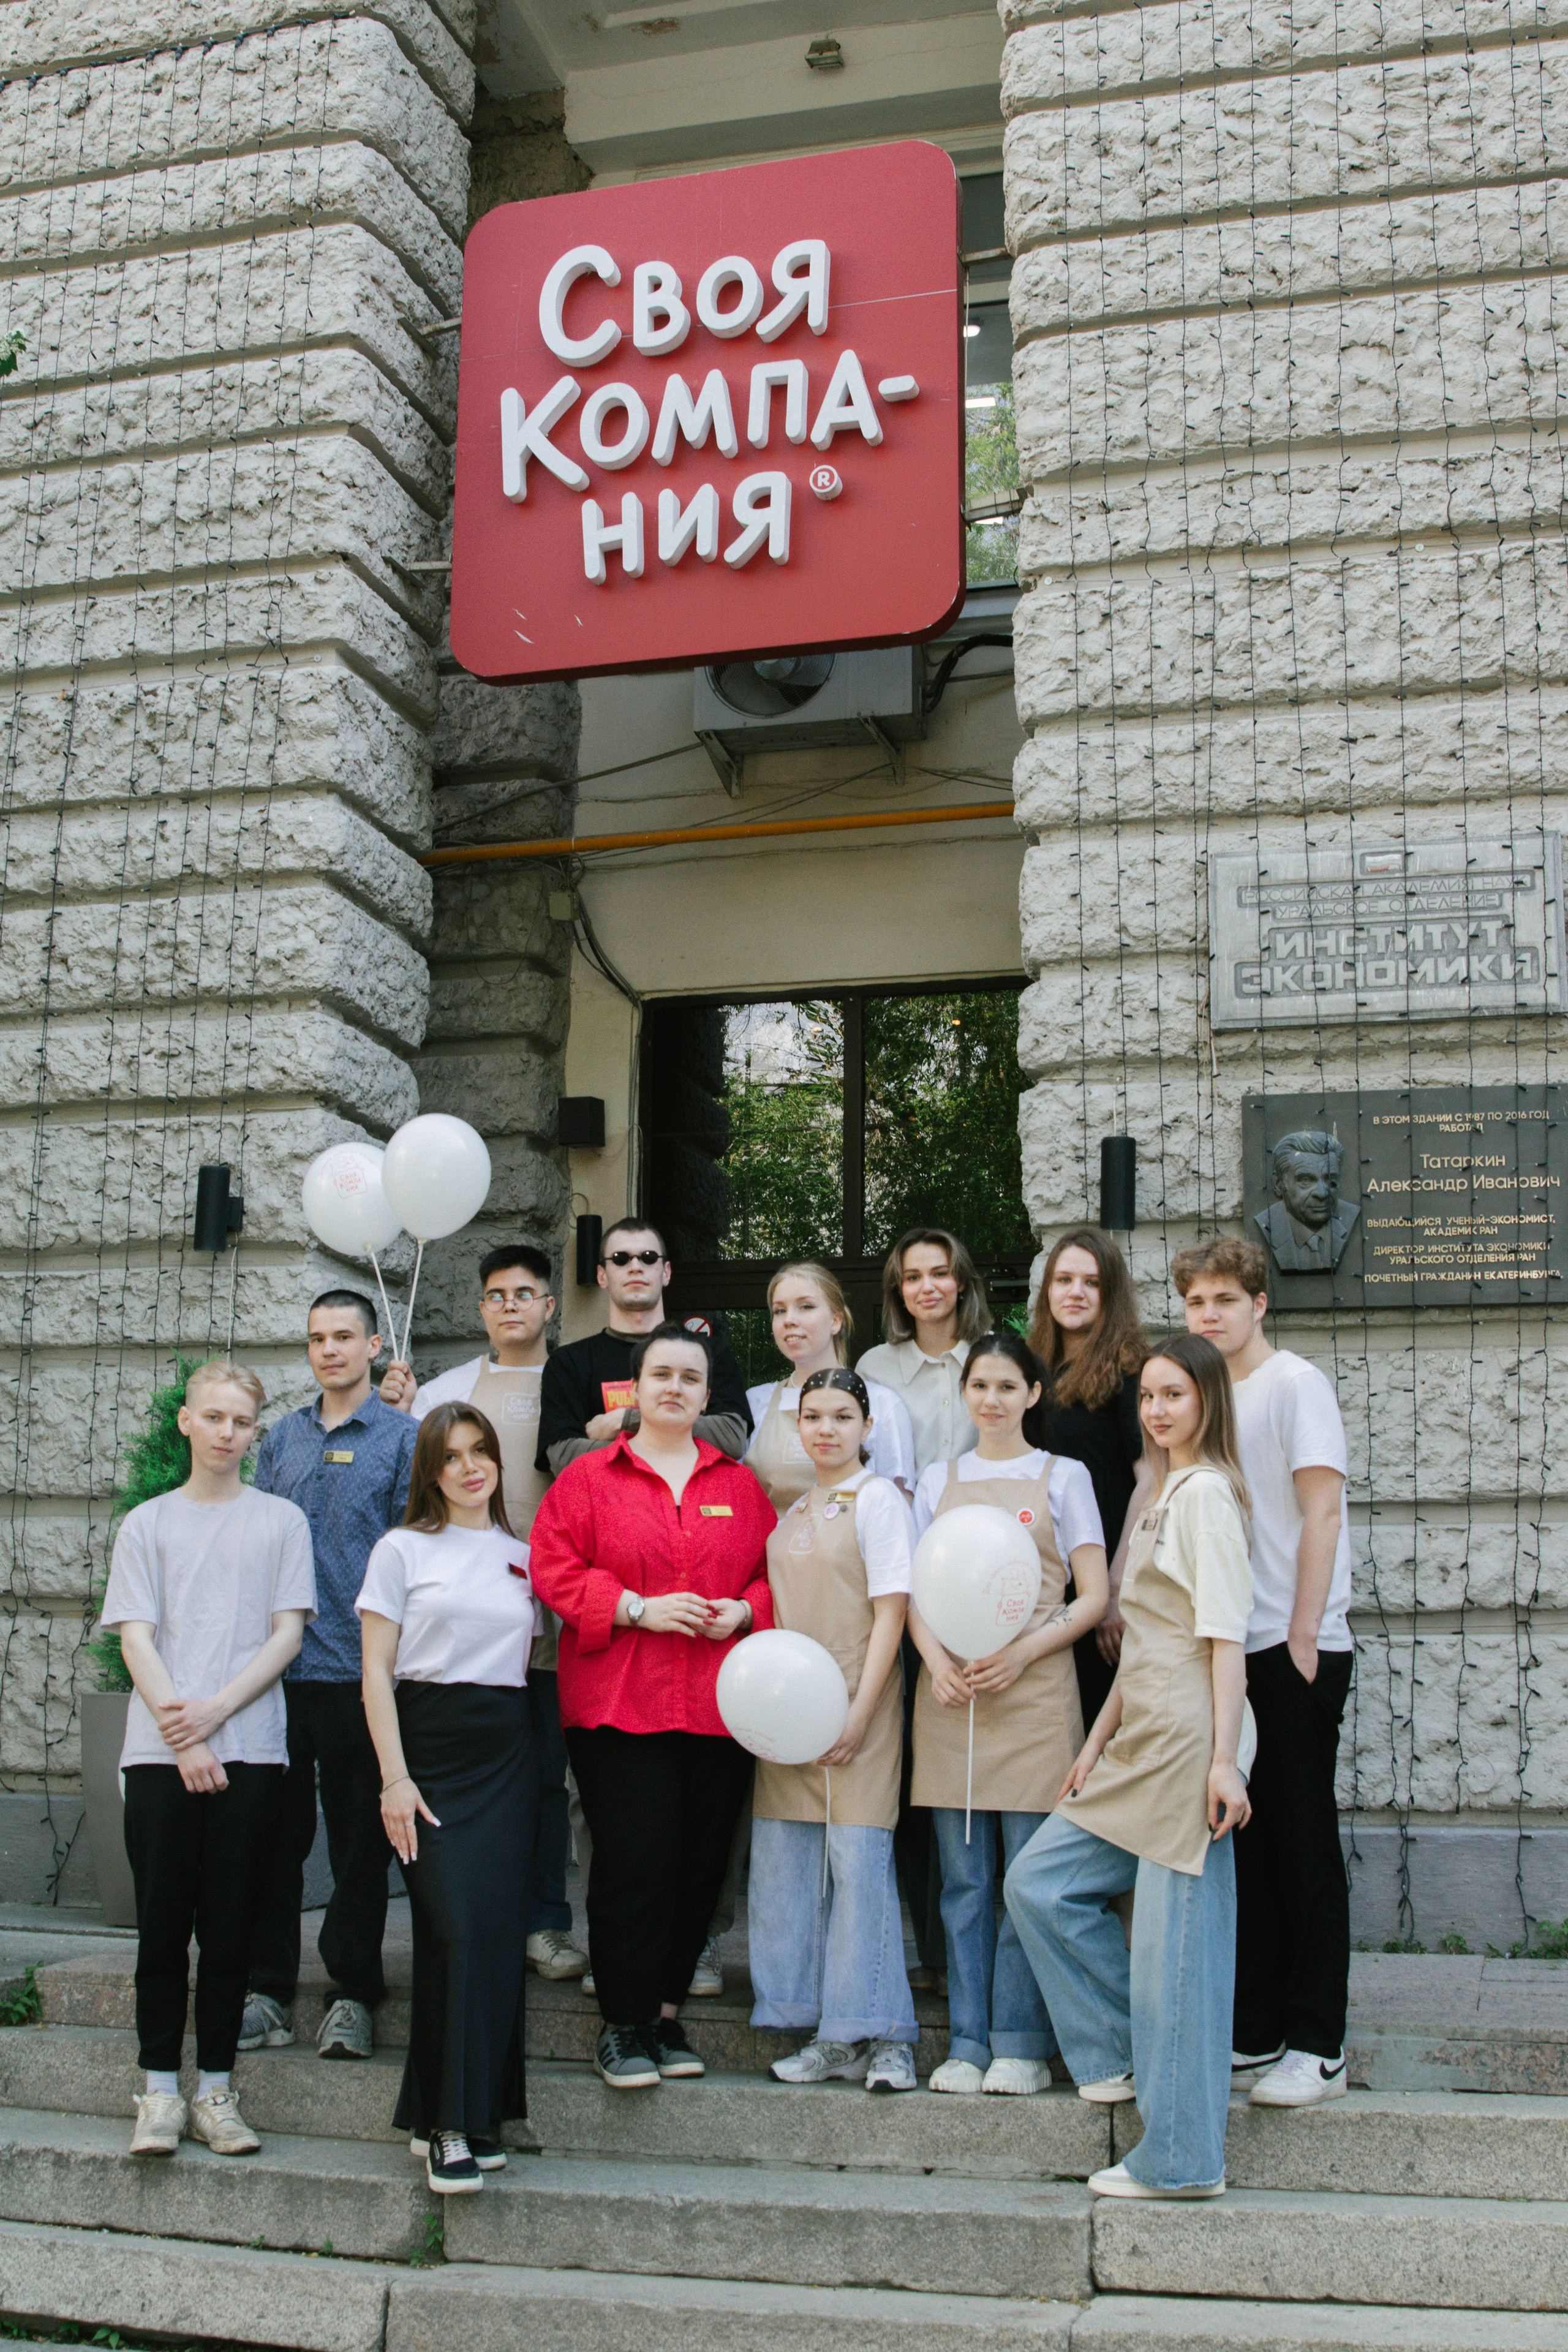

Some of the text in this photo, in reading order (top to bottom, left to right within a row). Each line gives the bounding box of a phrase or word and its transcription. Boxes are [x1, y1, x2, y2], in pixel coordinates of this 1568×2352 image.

[1372, 877, 1474, 896] АКАДЕМИЯ
[1277, 893, 1496, 918] УРАЛЬСКОЕ ОТДЕЛЕНИЕ
[1275, 920, 1504, 959] ИНСТИТУТ
[1241, 952, 1531, 994] ЭКОНОМИКИ
[1373, 1110, 1550, 1125] В ЭТОМ ЗДАНИИ С 1987 ПО 2016 ГОД
[1419, 1154, 1506, 1169] Татаркин
[1367, 1174, 1561, 1193] Александр Иванович
[1366, 1216, 1441, 1228] ВЫДАЮЩИЙСЯ
[1423, 1226, 1498, 1236] АКАДЕМИК РАН
[1373, 1245, 1425, 1256] ДИРЕКТОР
[1428, 1243, 1485, 1253] ИНСТИТУТА
[1389, 1255, 1454, 1265] УРАЛЬСКОГО
[1457, 1253, 1515, 1264] ОТДЕЛЕНИЯ
[1364, 1271, 1419, 1283] ПОЧЕТНЫЙ
[1420, 1270, 1482, 1281] ГРАЖДАНИН
